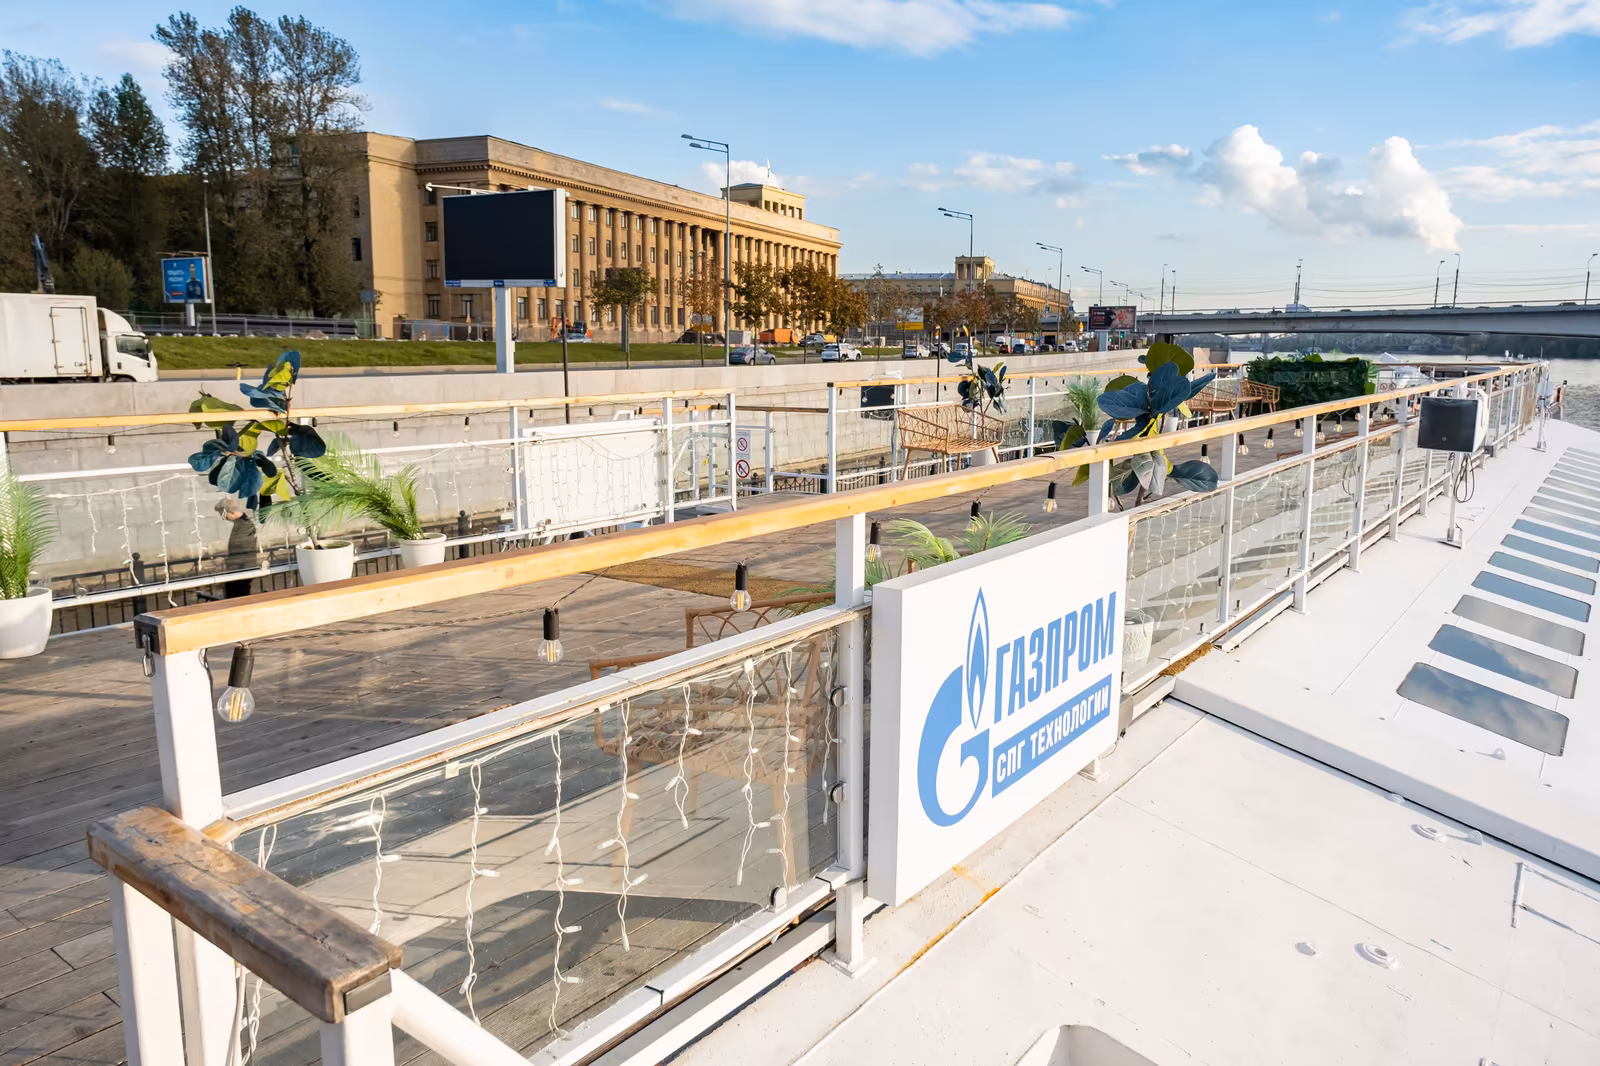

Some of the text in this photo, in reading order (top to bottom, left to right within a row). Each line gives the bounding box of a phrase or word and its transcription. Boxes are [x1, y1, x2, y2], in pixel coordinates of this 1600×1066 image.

[994, 591, 1117, 725] ГАЗПРОМ
[997, 685, 1109, 783] СПГ ТЕХНОЛОГИИ
